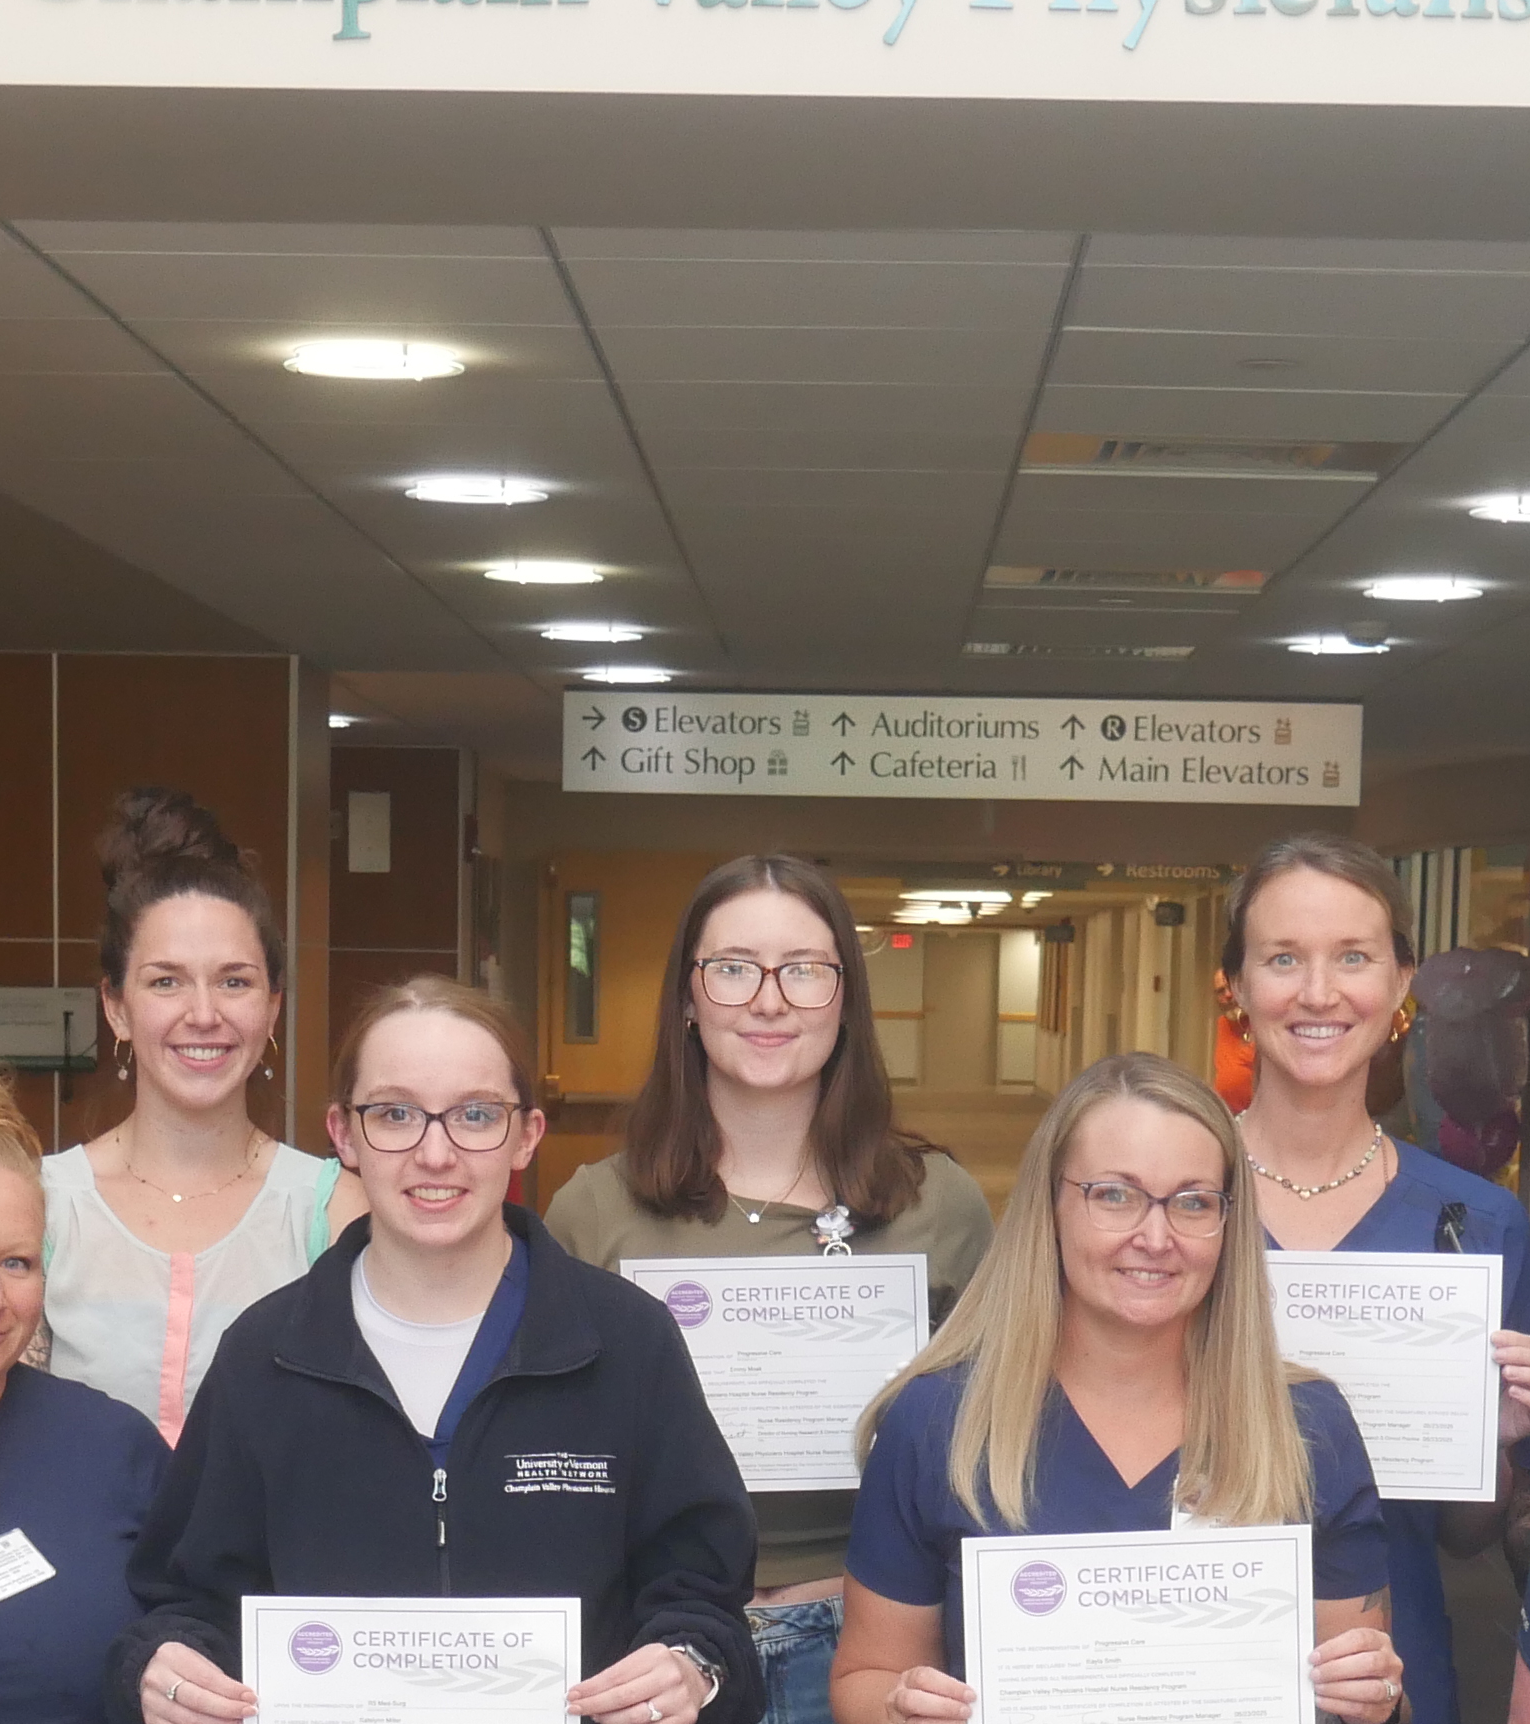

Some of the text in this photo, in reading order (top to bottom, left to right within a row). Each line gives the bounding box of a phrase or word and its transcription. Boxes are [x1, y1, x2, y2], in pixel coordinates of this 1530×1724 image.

[655, 705, 782, 736] Elevators
[871, 710, 1040, 740] Auditoriums
[1134, 715, 1261, 744] Elevators
[620, 746, 756, 784] Gift Shop
[869, 751, 998, 779] Cafeteria
[1099, 756, 1310, 786] Main Elevators
[1016, 865, 1063, 878] Library
[1125, 863, 1221, 879] Restrooms
[722, 1285, 885, 1303] CERTIFICATE OF
[1287, 1283, 1458, 1301] CERTIFICATE OF
[723, 1305, 855, 1322] COMPLETION
[1286, 1303, 1424, 1321] COMPLETION
[516, 1459, 562, 1470] University
[568, 1459, 608, 1470] Vermont
[517, 1469, 608, 1478] HEALTH NETWORK
[1077, 1561, 1264, 1584] CERTIFICATE OF
[1078, 1585, 1228, 1607] COMPLETION
[352, 1631, 534, 1648] CERTIFICATE OF
[1094, 1639, 1130, 1647] Progressive
[353, 1652, 498, 1669] COMPLETION
